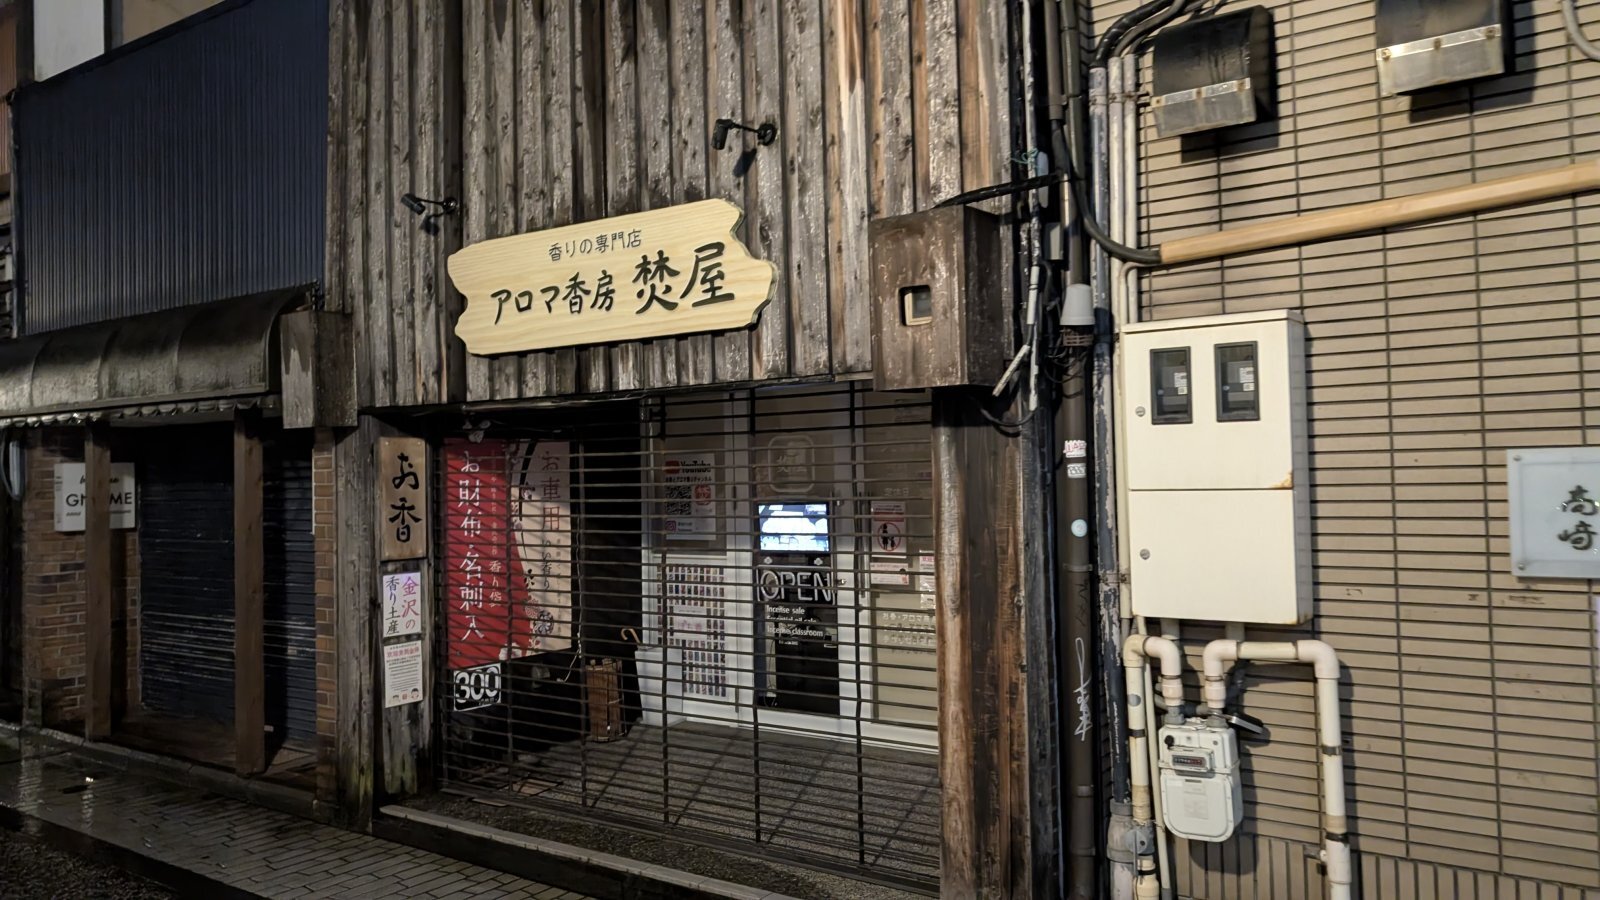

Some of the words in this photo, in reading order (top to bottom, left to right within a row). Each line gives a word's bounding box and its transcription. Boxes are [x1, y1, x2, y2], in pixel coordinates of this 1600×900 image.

[547, 228, 642, 262] 香りの専門店
[490, 270, 616, 325] アロマ香房
[631, 241, 736, 315] 焚屋
[66, 492, 132, 507] GME
[389, 452, 422, 544] お香
[540, 450, 561, 531] お車用
[386, 576, 401, 635] 香り土産
[401, 576, 420, 631] 金沢の
[760, 571, 832, 602] OPEN
[766, 604, 790, 614] Incense
[791, 606, 806, 615] sale
[882, 612, 936, 622] お香・アロマ
[455, 666, 499, 704] 300
